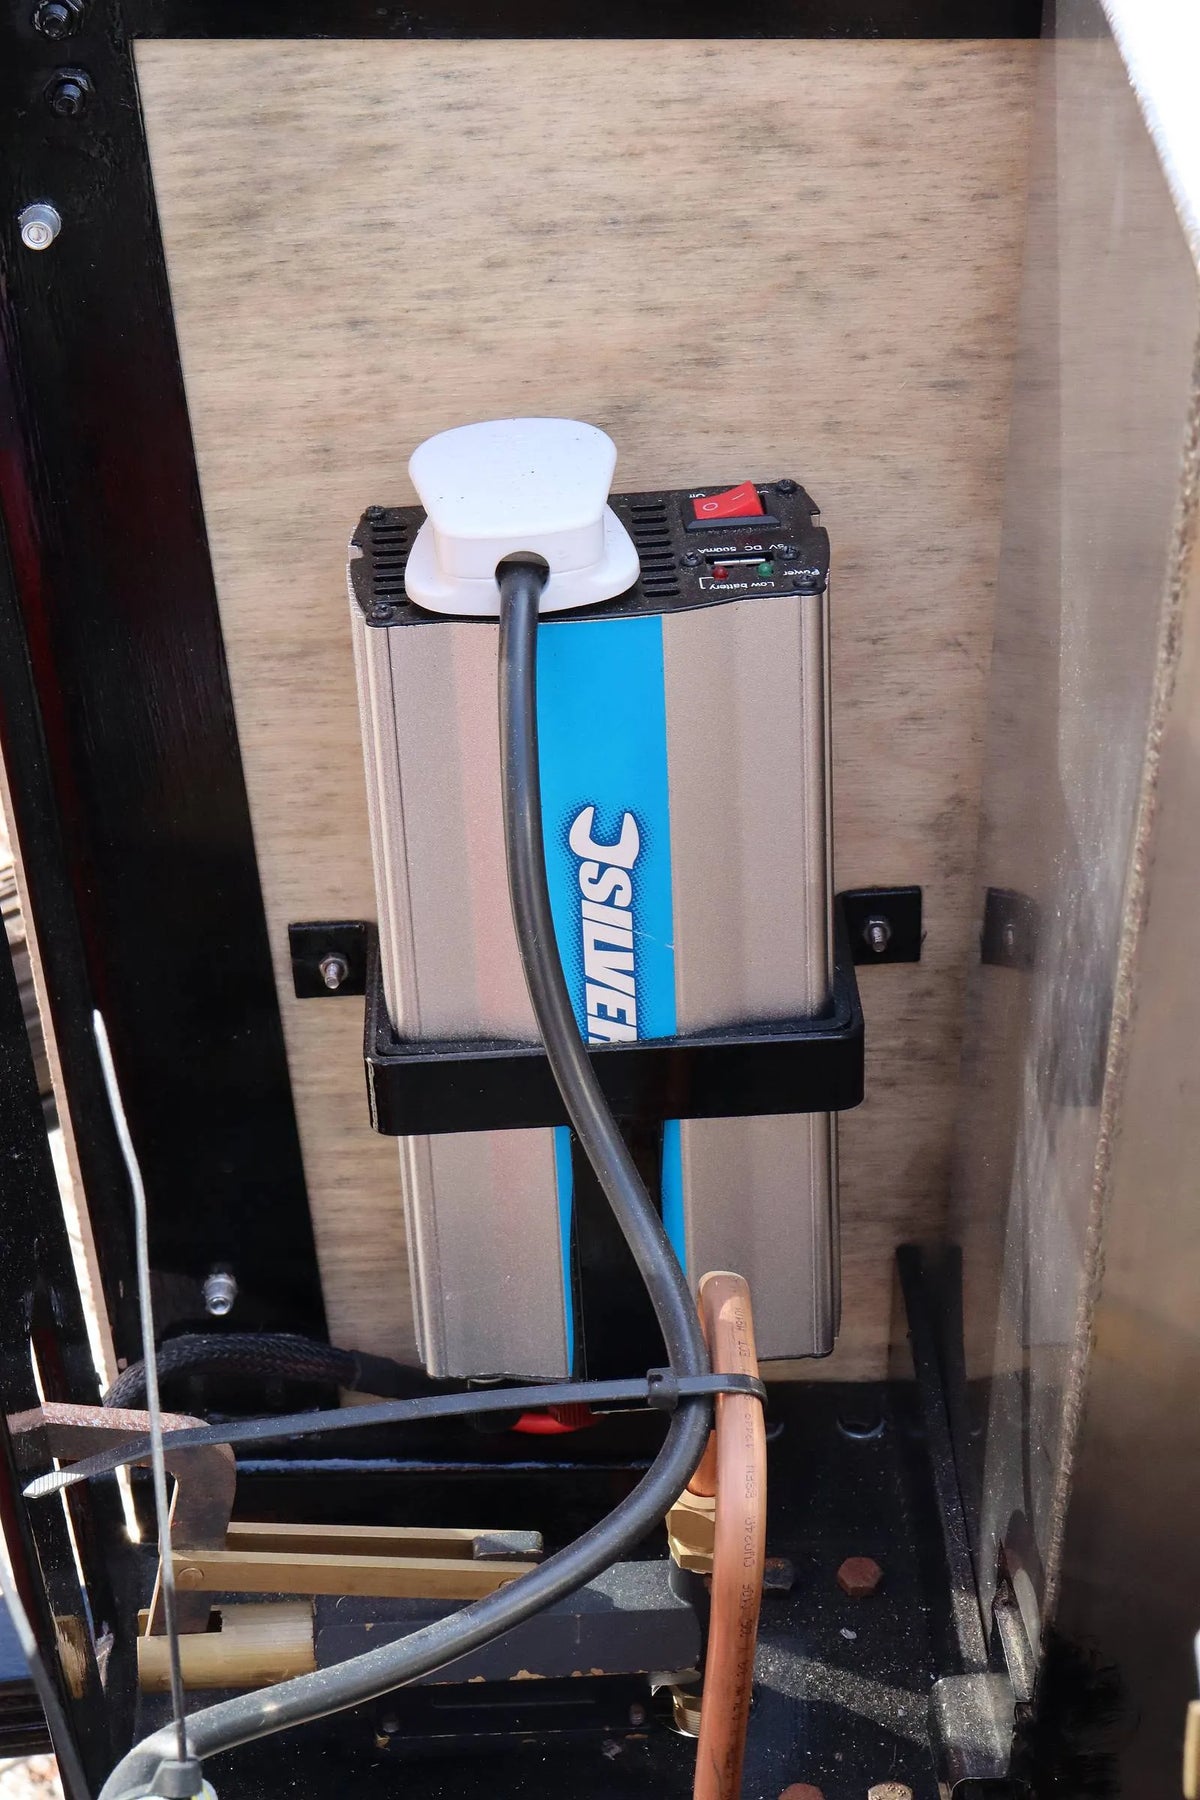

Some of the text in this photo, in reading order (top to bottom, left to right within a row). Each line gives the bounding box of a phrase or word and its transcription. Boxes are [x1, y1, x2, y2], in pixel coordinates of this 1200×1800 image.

[697, 546, 737, 554] 500mA
[744, 544, 763, 552] DC
[783, 568, 821, 577] Power
[709, 582, 748, 590] battery
